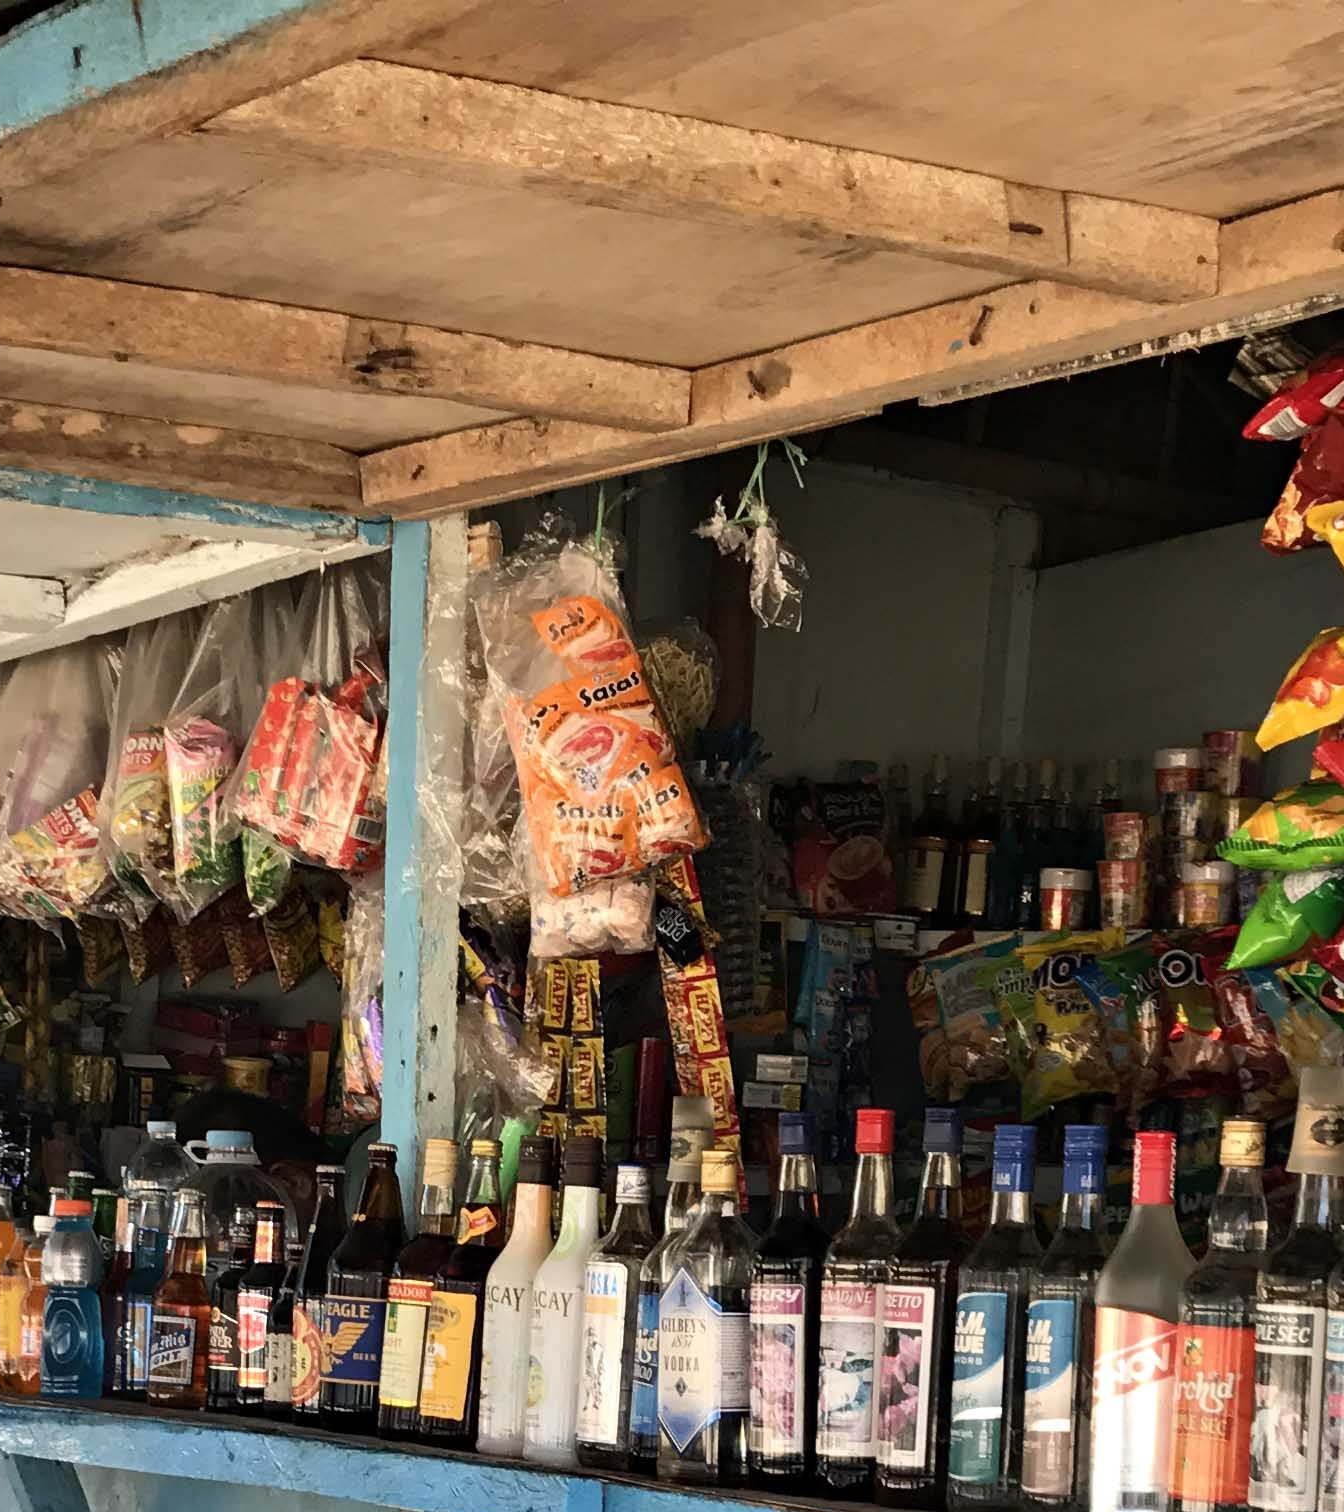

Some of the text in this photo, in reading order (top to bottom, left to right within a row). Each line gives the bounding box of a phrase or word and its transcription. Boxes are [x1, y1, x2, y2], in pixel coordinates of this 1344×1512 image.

[578, 671, 640, 708] Sasas
[124, 737, 164, 751] ORN
[551, 969, 566, 1026] HAPPY
[575, 973, 591, 1030] HAPPY
[577, 1051, 594, 1107] HAPPY
[751, 1287, 801, 1303] ERRY
[327, 1304, 371, 1319] EAGLE
[662, 1317, 706, 1334] GILBEY'S
[1277, 1325, 1311, 1343] SEC
[353, 1352, 377, 1362] BEER
[664, 1355, 701, 1373] VODKA
[1176, 1372, 1235, 1413] rchid
